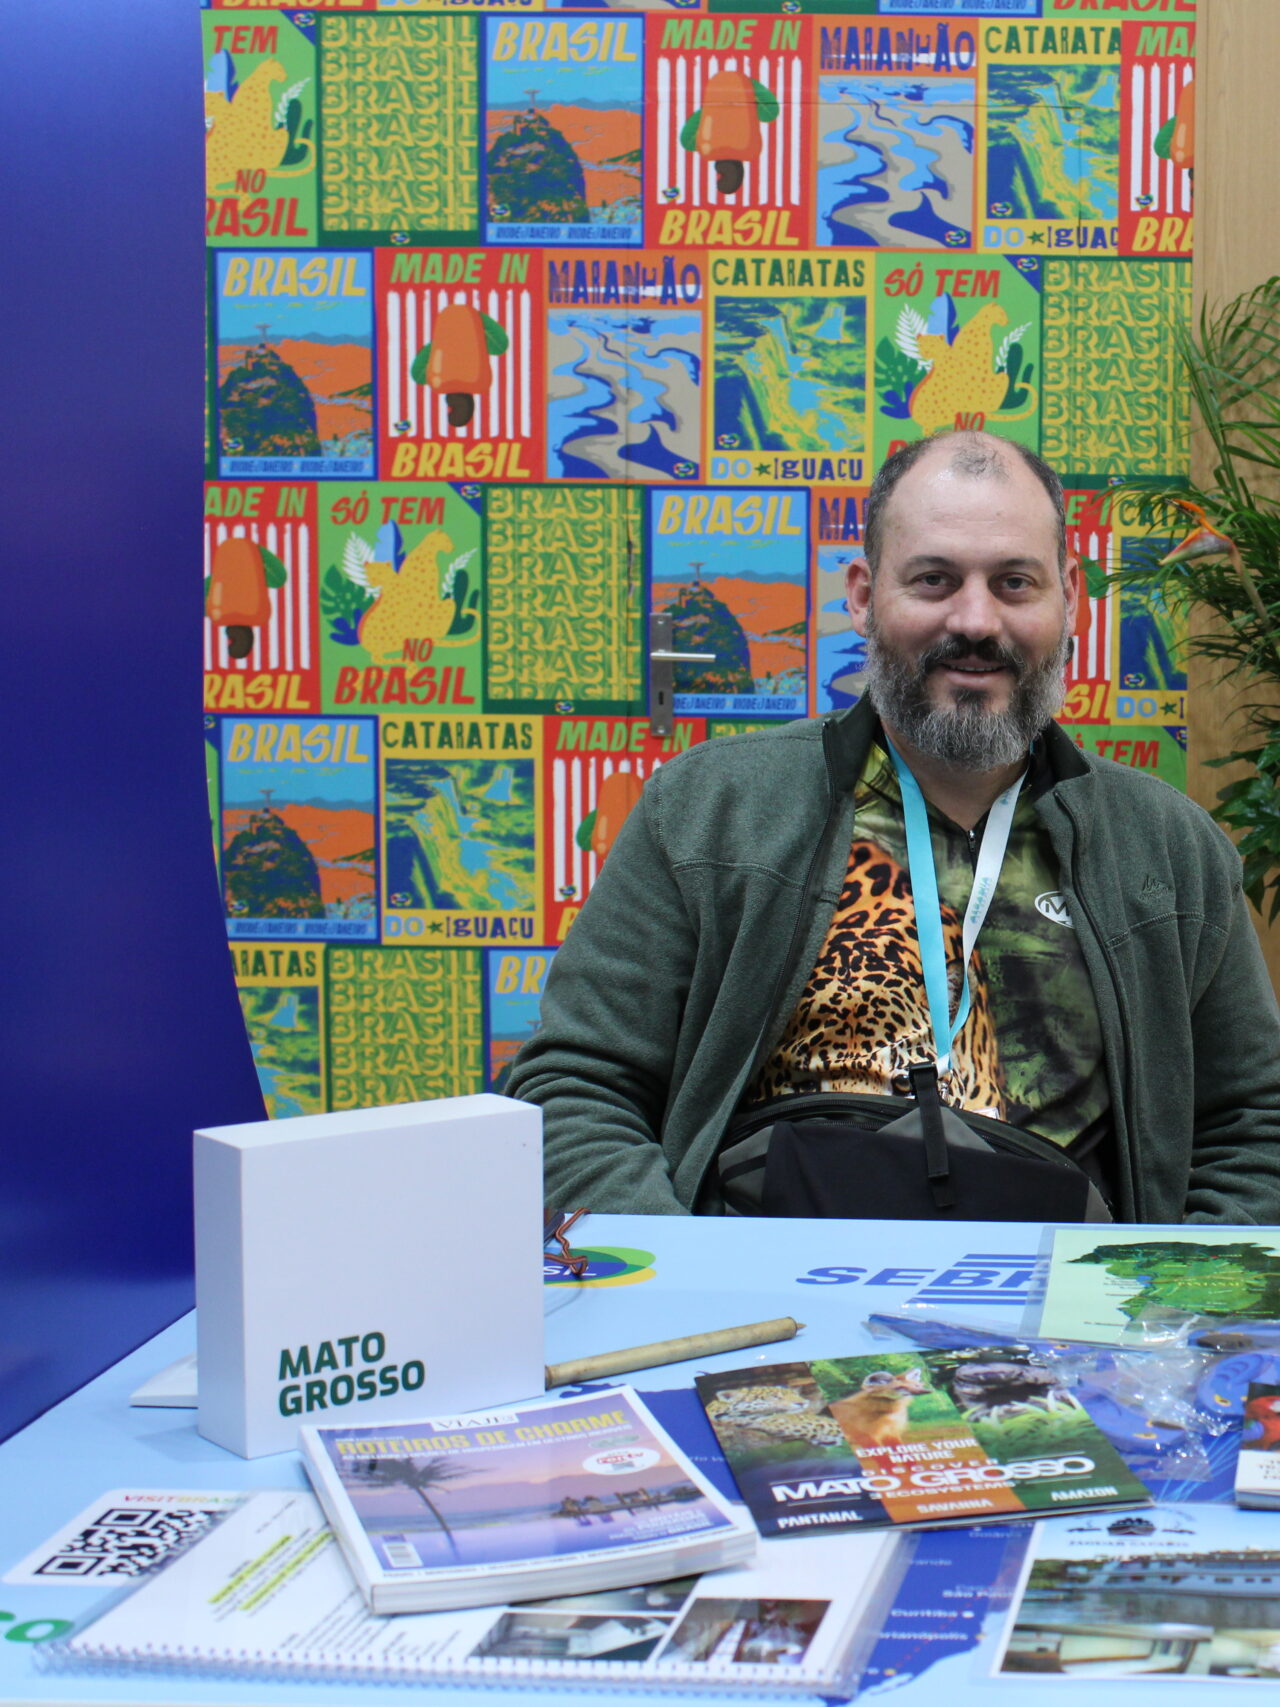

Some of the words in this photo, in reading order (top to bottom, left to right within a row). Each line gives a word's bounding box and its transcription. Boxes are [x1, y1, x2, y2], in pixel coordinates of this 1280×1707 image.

[213, 25, 279, 54] TEM
[321, 17, 478, 47] BRASIL
[492, 22, 638, 62] BRASIL
[660, 18, 757, 50] MADE
[769, 19, 802, 51] IN
[1135, 26, 1195, 57] MA
[321, 51, 478, 81] BRASIL
[321, 84, 478, 114] BRASIL
[321, 117, 478, 147] BRASIL
[234, 168, 267, 194] NO
[321, 151, 478, 181] BRASIL
[321, 184, 478, 214] BRASIL
[658, 209, 800, 246] BRASIL
[983, 224, 1025, 248] DO
[223, 257, 367, 297] BRASIL
[389, 252, 487, 284] MADE
[498, 253, 531, 284] IN
[711, 257, 865, 287] CATARATAS
[883, 261, 924, 298] SÓ
[934, 268, 1001, 298] TEM
[1042, 260, 1192, 293] BRASIL
[1042, 293, 1192, 325] BRASIL
[1042, 326, 1192, 358] BRASIL
[1042, 359, 1192, 391] BRASIL
[953, 411, 986, 433] NO
[1042, 392, 1192, 424] BRASIL
[1042, 425, 1192, 457] BRASIL
[391, 442, 531, 478] BRASIL
[710, 456, 753, 480] DO
[204, 487, 265, 518] ADE
[276, 487, 308, 518] IN
[330, 490, 370, 526] SÓ
[379, 496, 446, 525] TEM
[487, 487, 641, 519] BRASIL
[657, 495, 803, 536] BRASIL
[487, 520, 641, 552] BRASIL
[487, 553, 641, 585] BRASIL
[487, 586, 641, 618] BRASIL
[401, 637, 434, 663] NO
[487, 619, 641, 651] BRASIL
[487, 652, 641, 684] BRASIL
[204, 674, 311, 710] RASIL
[333, 666, 476, 705] BRASIL
[1116, 696, 1158, 718] DO
[227, 723, 370, 764] BRASIL
[382, 720, 533, 750] CATARATAS
[555, 720, 646, 753] MADE
[1095, 740, 1161, 769] TEM
[384, 915, 426, 937] DO
[329, 950, 482, 980] BRASIL
[329, 982, 482, 1013] BRASIL
[329, 1014, 482, 1044] BRASIL
[329, 1045, 482, 1076] BRASIL
[329, 1076, 482, 1108] BRASIL
[278, 1331, 386, 1382] MATO
[279, 1359, 426, 1418] GROSSO
[336, 1433, 472, 1455] ROTEIROS
[474, 1428, 511, 1447] DE
[514, 1410, 630, 1443] CHARME
[855, 1441, 930, 1457] EXPLORE
[931, 1437, 979, 1451] YOUR
[861, 1458, 999, 1477] DISCOVER
[890, 1450, 955, 1464] NATURE
[770, 1475, 901, 1503] MATO
[910, 1456, 1096, 1490] GROSSO
[884, 1480, 1016, 1500] ECOSYSTEMS
[776, 1510, 863, 1529] PANTANAL
[916, 1498, 994, 1514] SAVANNA
[1050, 1486, 1119, 1502] AMAZON
